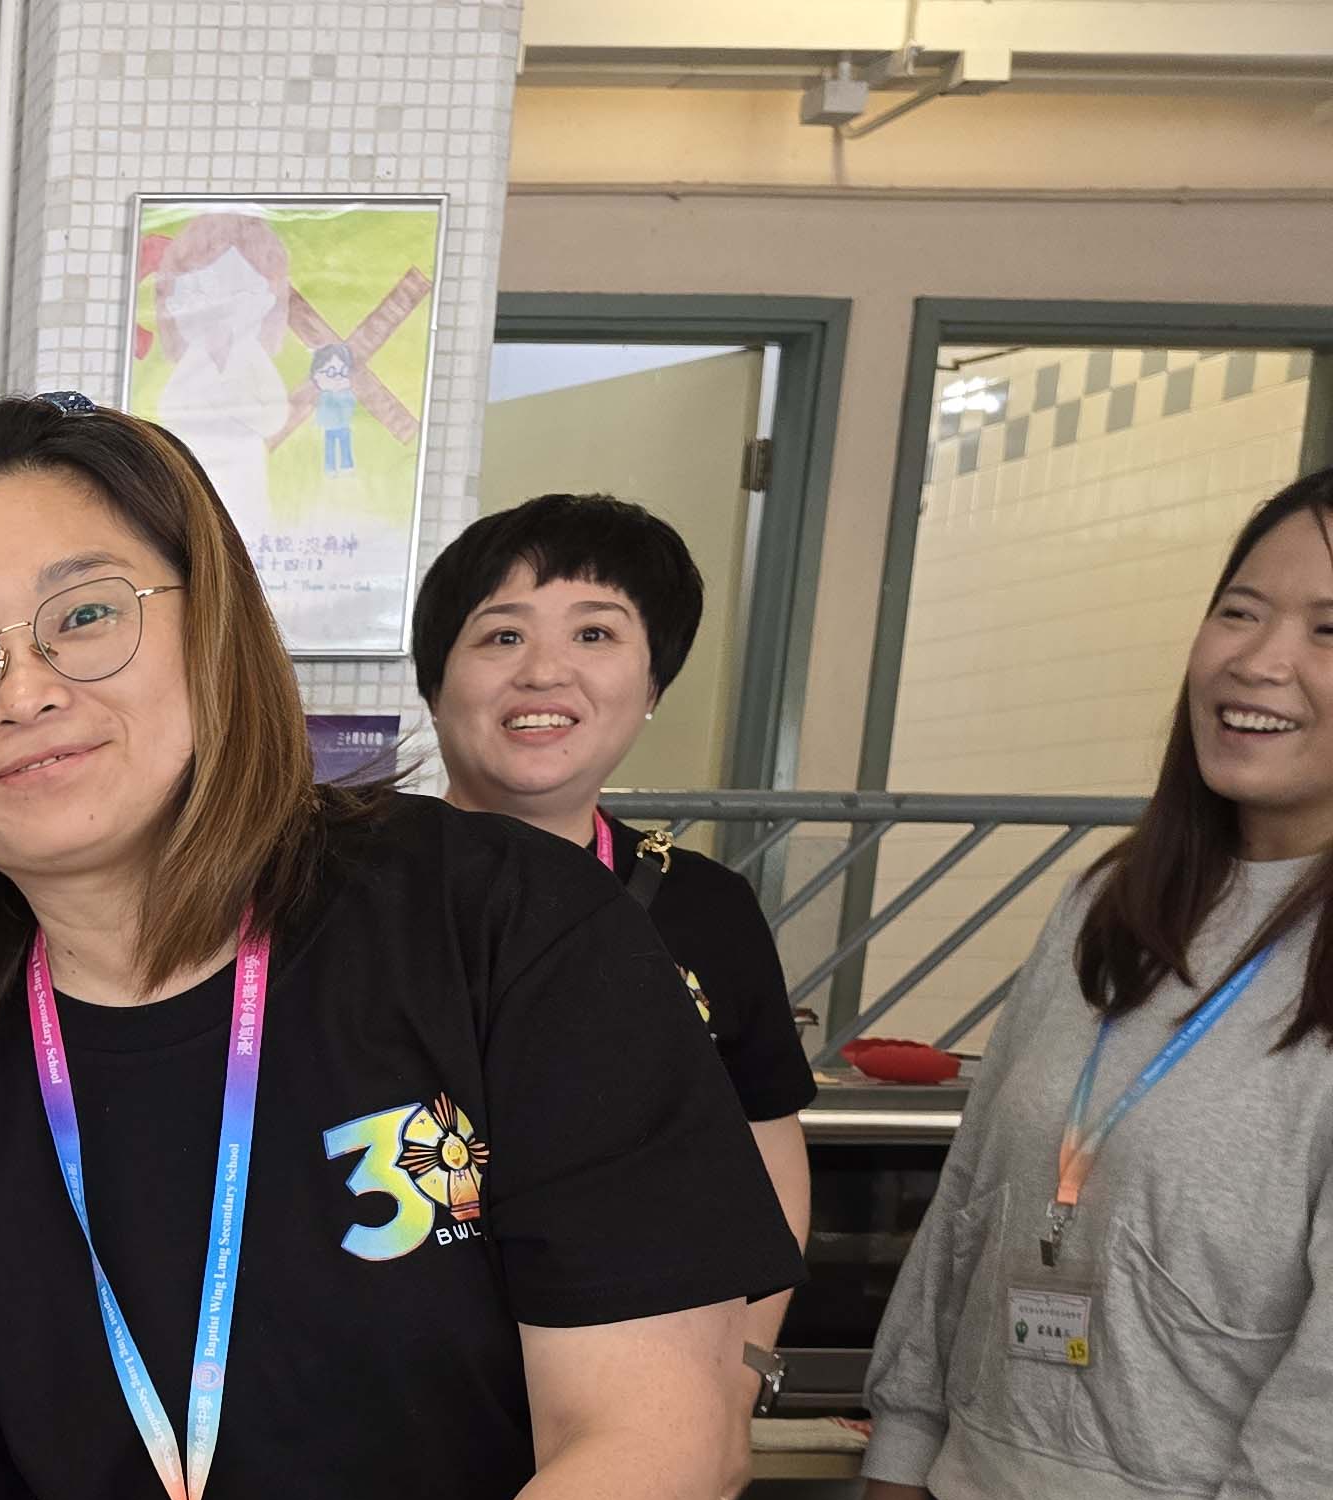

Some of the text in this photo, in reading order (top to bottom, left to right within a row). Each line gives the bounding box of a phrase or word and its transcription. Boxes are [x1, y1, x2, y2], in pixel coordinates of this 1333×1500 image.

[36, 989, 54, 1047] Secondary
[45, 1046, 63, 1085] School
[203, 1143, 241, 1358] Baptist Wing Lung Secondary School
[435, 1221, 487, 1247] BWL
[99, 1286, 118, 1328] Baptist
[113, 1325, 129, 1359] Wing
[123, 1356, 141, 1390] Lung
[134, 1384, 166, 1443] Secondary
